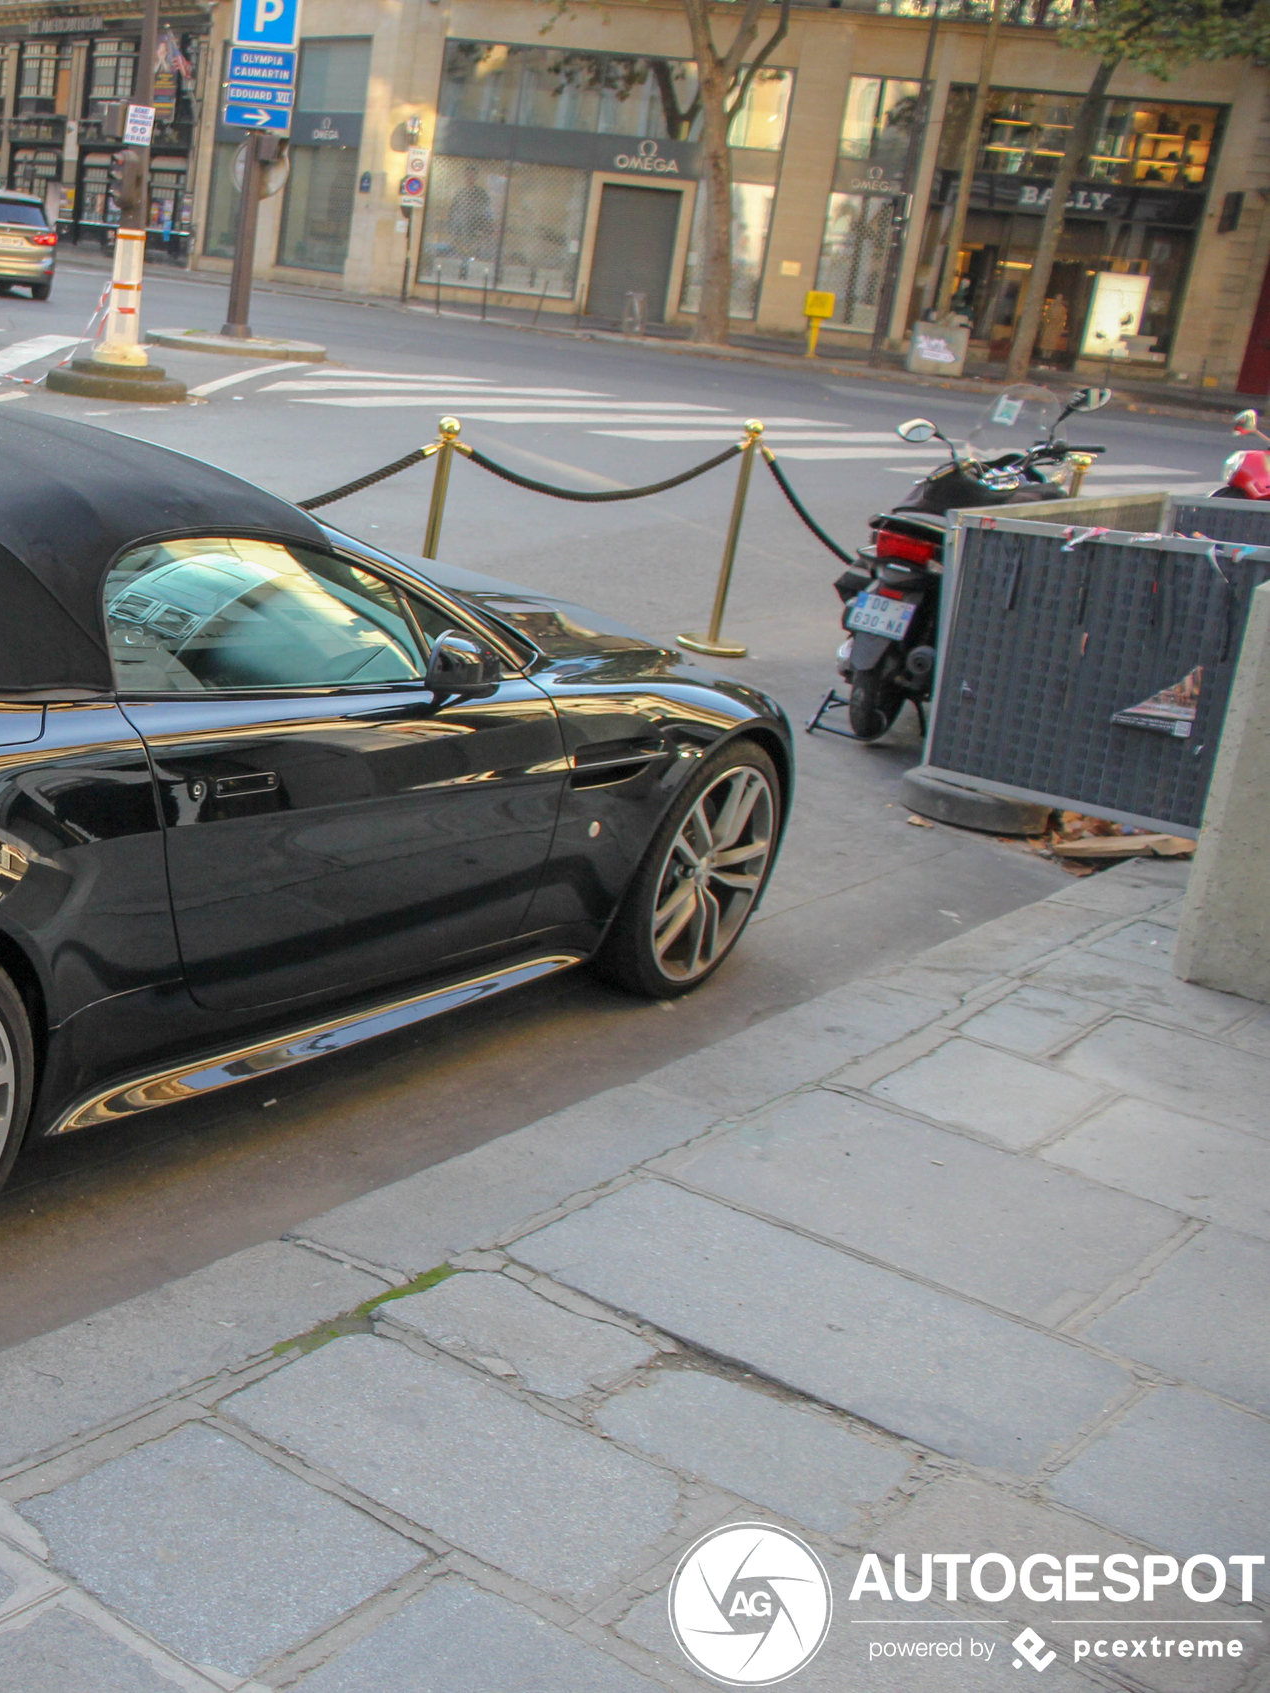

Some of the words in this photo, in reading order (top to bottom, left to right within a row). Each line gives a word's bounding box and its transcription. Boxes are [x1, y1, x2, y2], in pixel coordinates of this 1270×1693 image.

[254, 0, 285, 33] P
[242, 54, 283, 66] OLYMPIA
[234, 66, 290, 80] CAUMARTIN
[230, 88, 272, 101] EDOUARD
[275, 91, 291, 104] VII
[313, 130, 339, 139] OMEGA
[615, 154, 679, 174] OMEGA
[851, 178, 892, 192] OMEG
